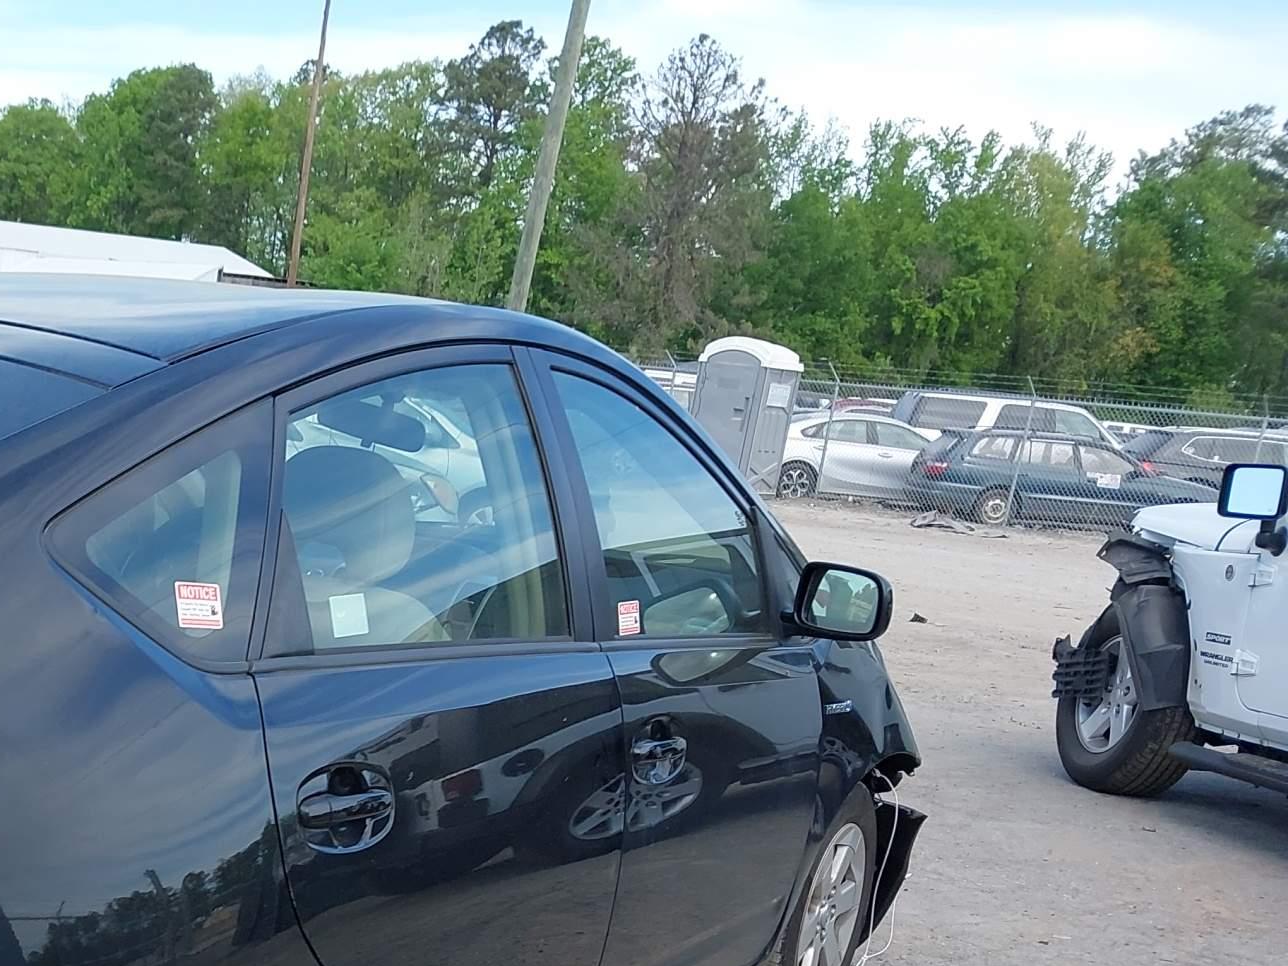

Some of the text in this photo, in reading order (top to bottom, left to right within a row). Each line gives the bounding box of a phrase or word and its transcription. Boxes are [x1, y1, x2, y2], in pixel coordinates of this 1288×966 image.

[179, 585, 217, 600] NOTICE
[1206, 633, 1231, 645] SPORT
[1200, 651, 1234, 663] WRANGLER
